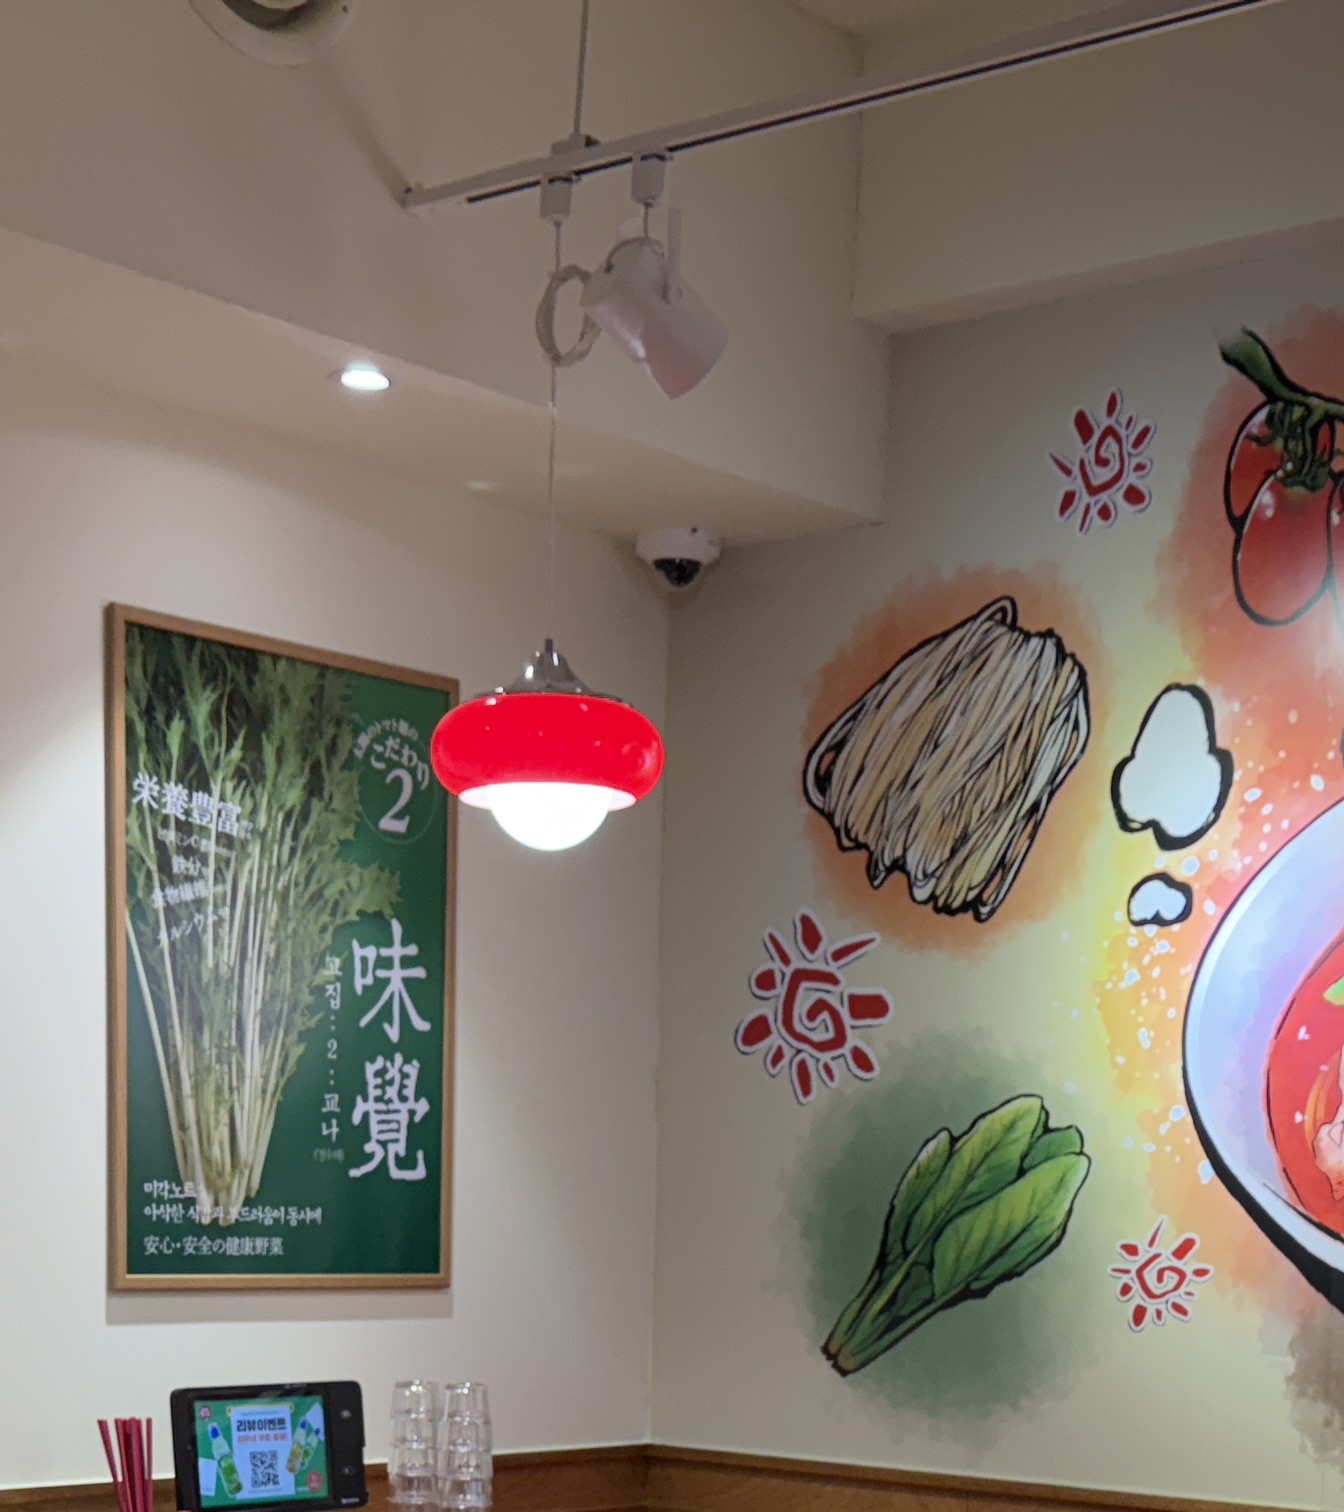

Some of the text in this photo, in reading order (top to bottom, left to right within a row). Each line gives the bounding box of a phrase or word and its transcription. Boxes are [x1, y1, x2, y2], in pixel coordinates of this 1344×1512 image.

[370, 735, 429, 790] こだわり
[378, 768, 413, 833] 2
